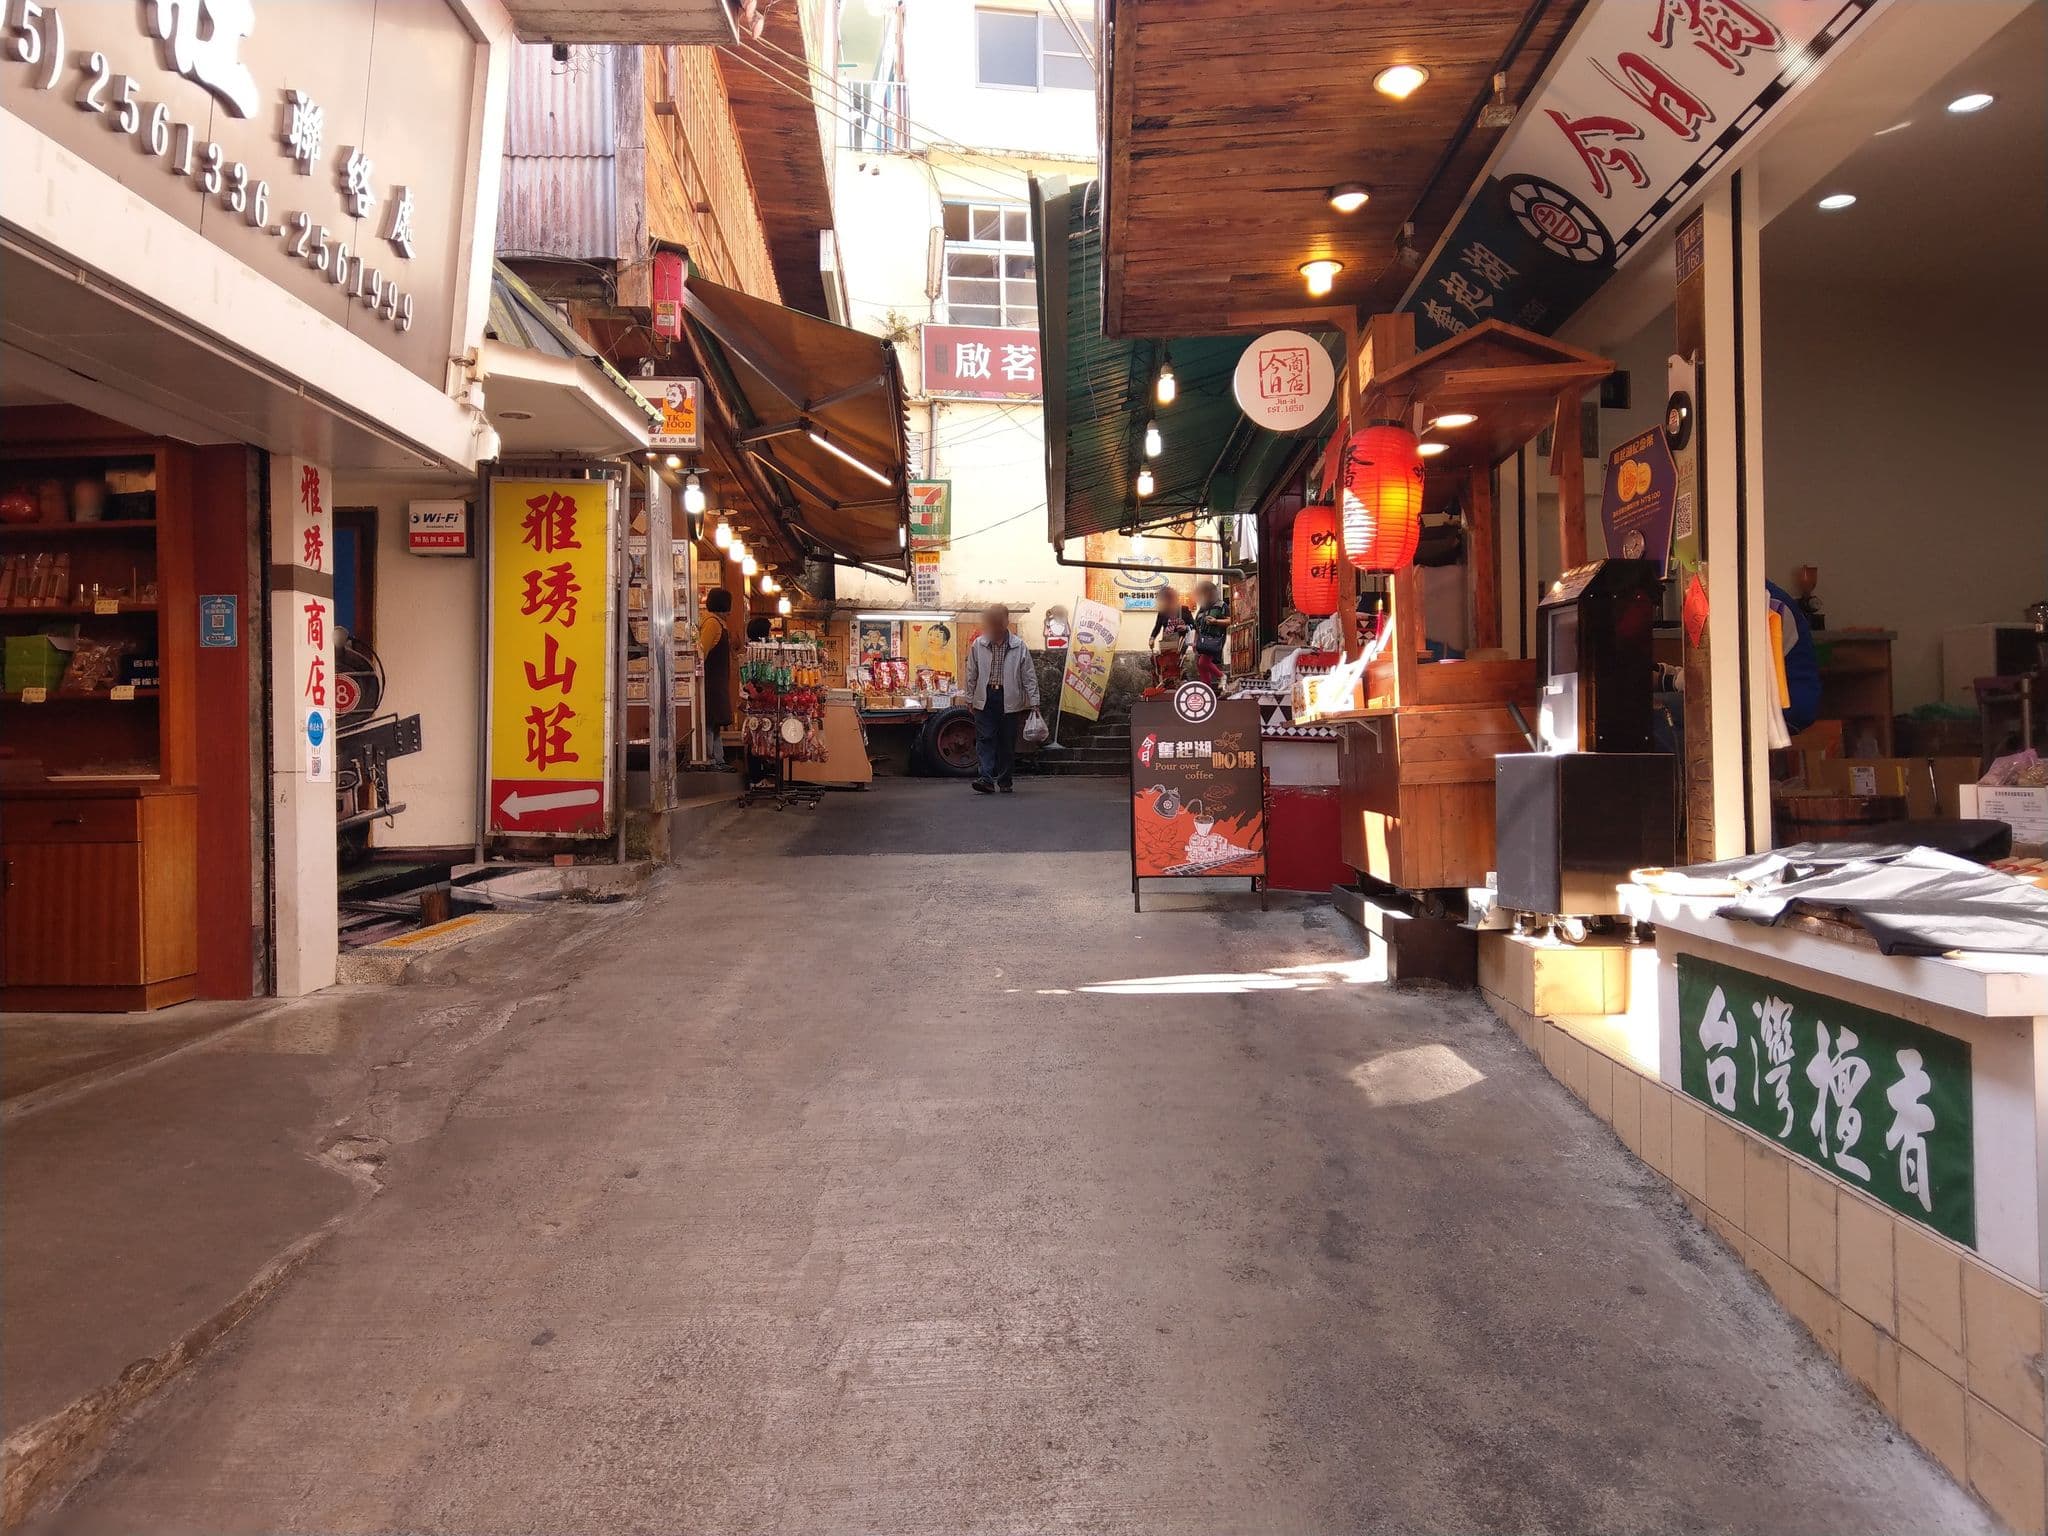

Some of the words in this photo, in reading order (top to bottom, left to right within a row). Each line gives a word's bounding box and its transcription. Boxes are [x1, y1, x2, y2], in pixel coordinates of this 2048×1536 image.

[423, 512, 460, 523] Wi-Fi
[1155, 762, 1177, 771] Pour
[1185, 769, 1214, 780] coffee
